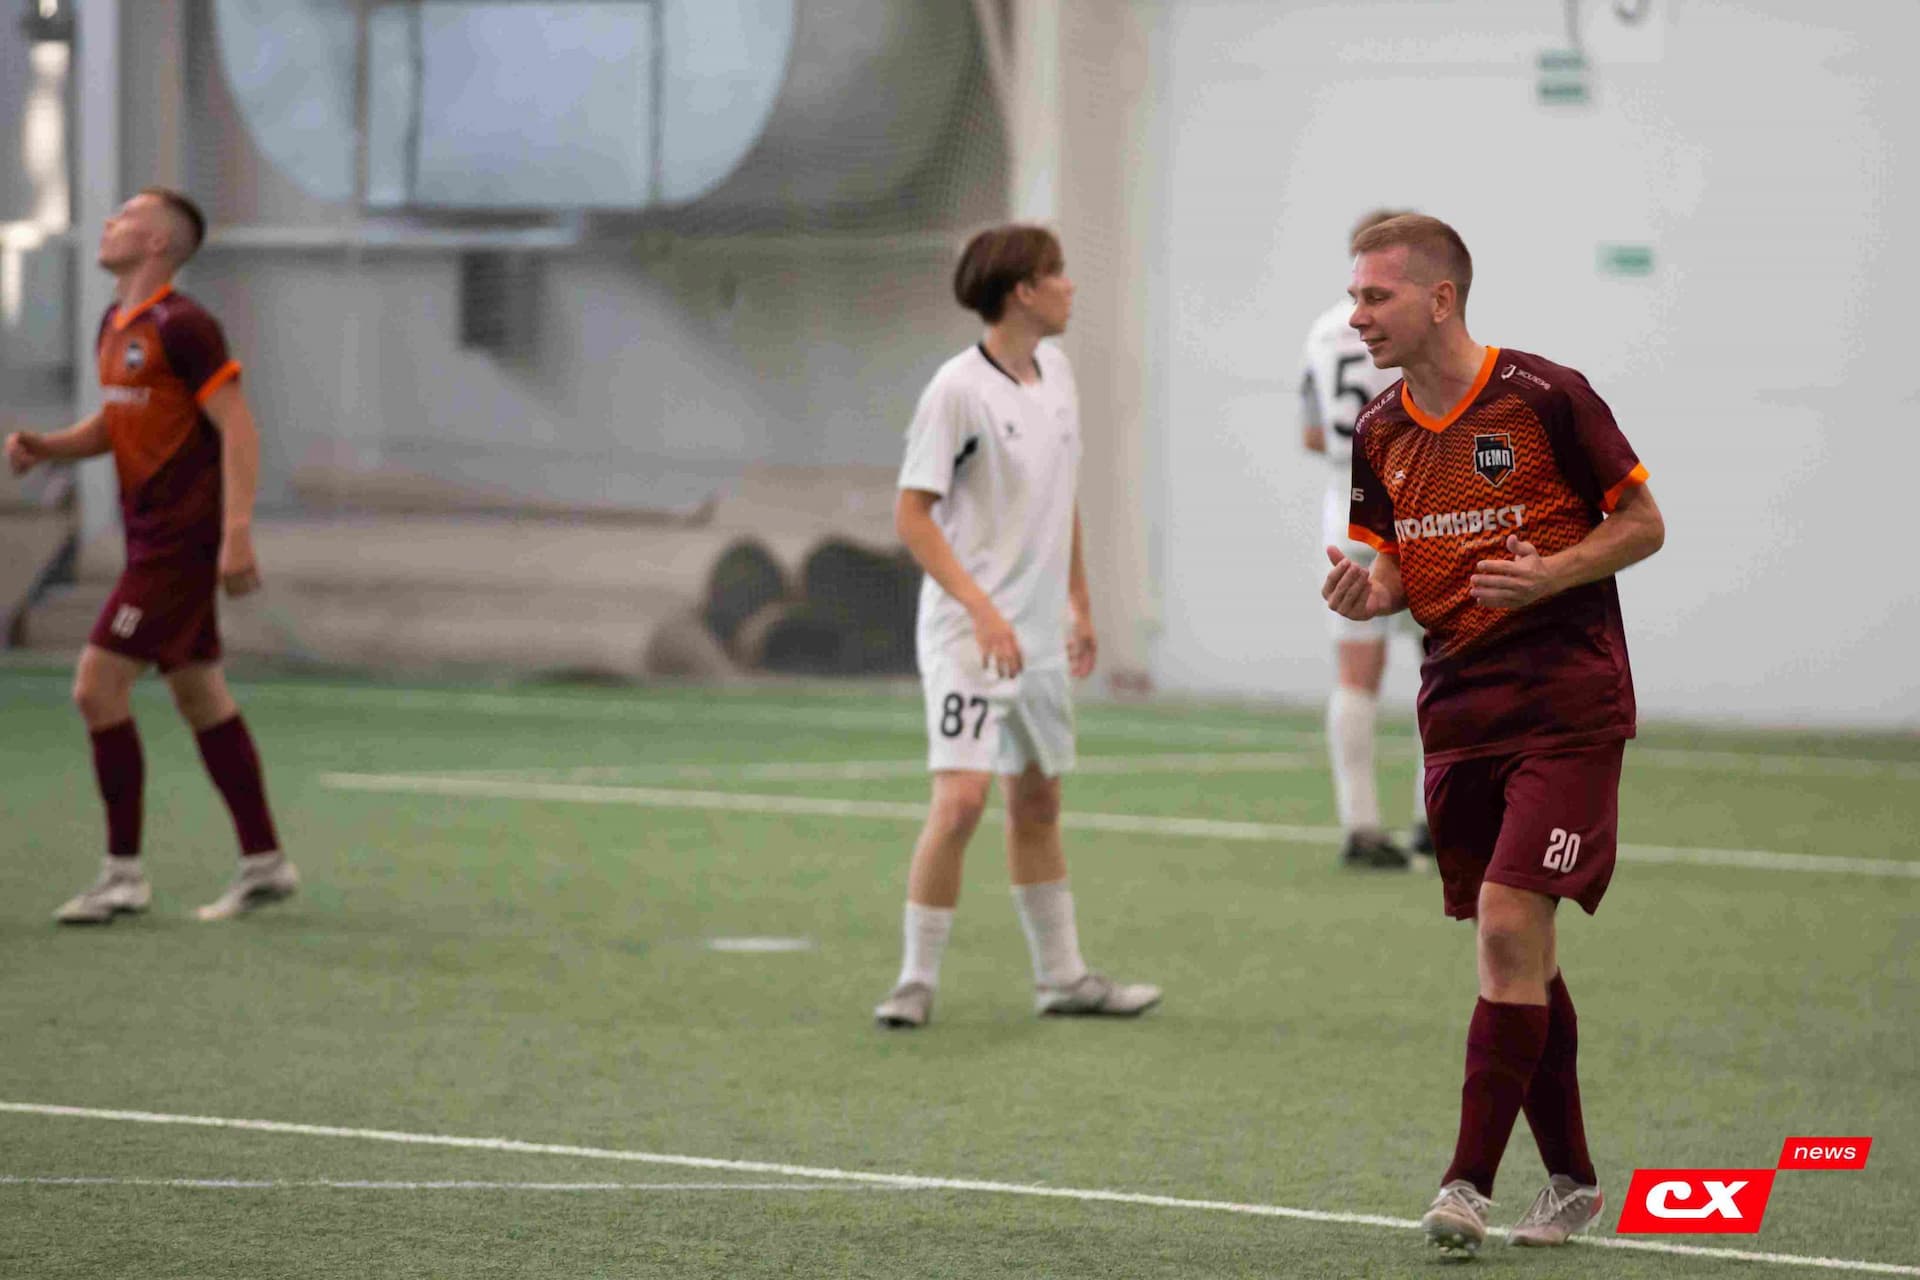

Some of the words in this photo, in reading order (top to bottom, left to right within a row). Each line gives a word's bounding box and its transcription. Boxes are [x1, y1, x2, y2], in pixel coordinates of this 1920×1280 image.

[1334, 352, 1369, 438] 5
[1477, 448, 1511, 468] ТЕМП
[941, 693, 988, 739] 87
[1542, 827, 1581, 873] 20
